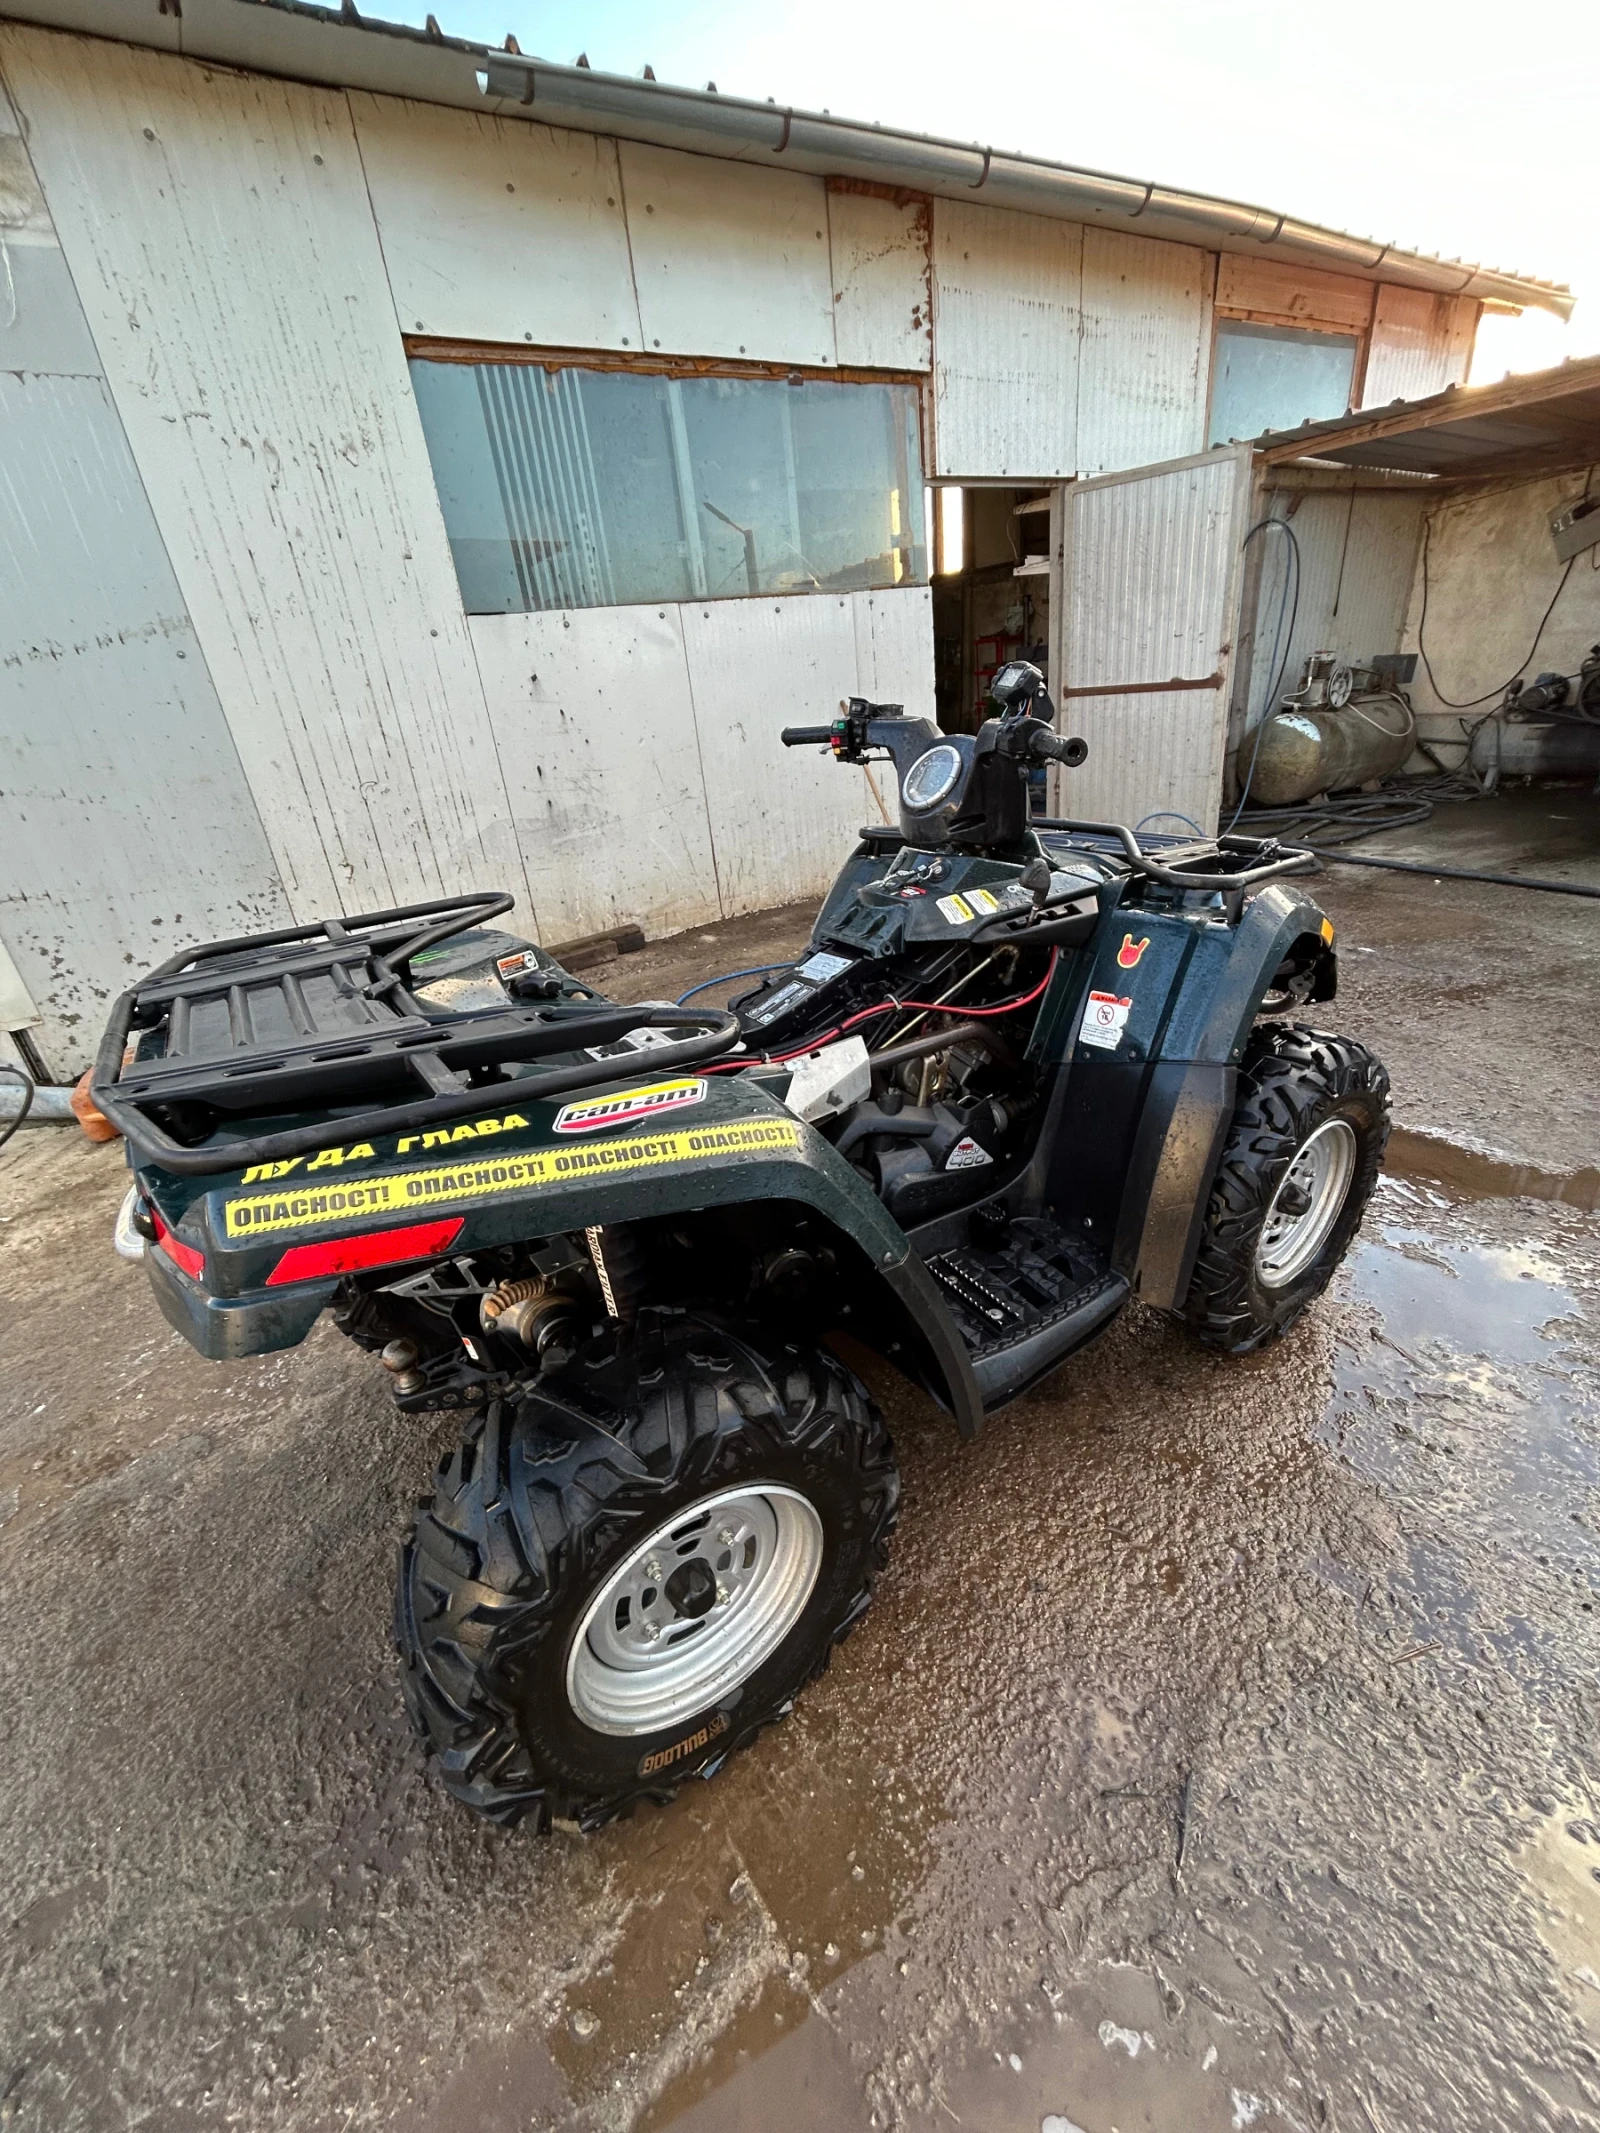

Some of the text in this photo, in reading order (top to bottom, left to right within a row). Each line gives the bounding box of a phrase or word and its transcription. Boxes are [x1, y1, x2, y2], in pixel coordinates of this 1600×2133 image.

[396, 1113, 530, 1154] ГЛАВА
[234, 1126, 794, 1228] ОПАСНОСТ! ОПАСНОСТ! ОПАСНОСТ! ОПАСНОСТ!
[949, 1154, 987, 1168] 400
[642, 1727, 709, 1775] BULLDOG
